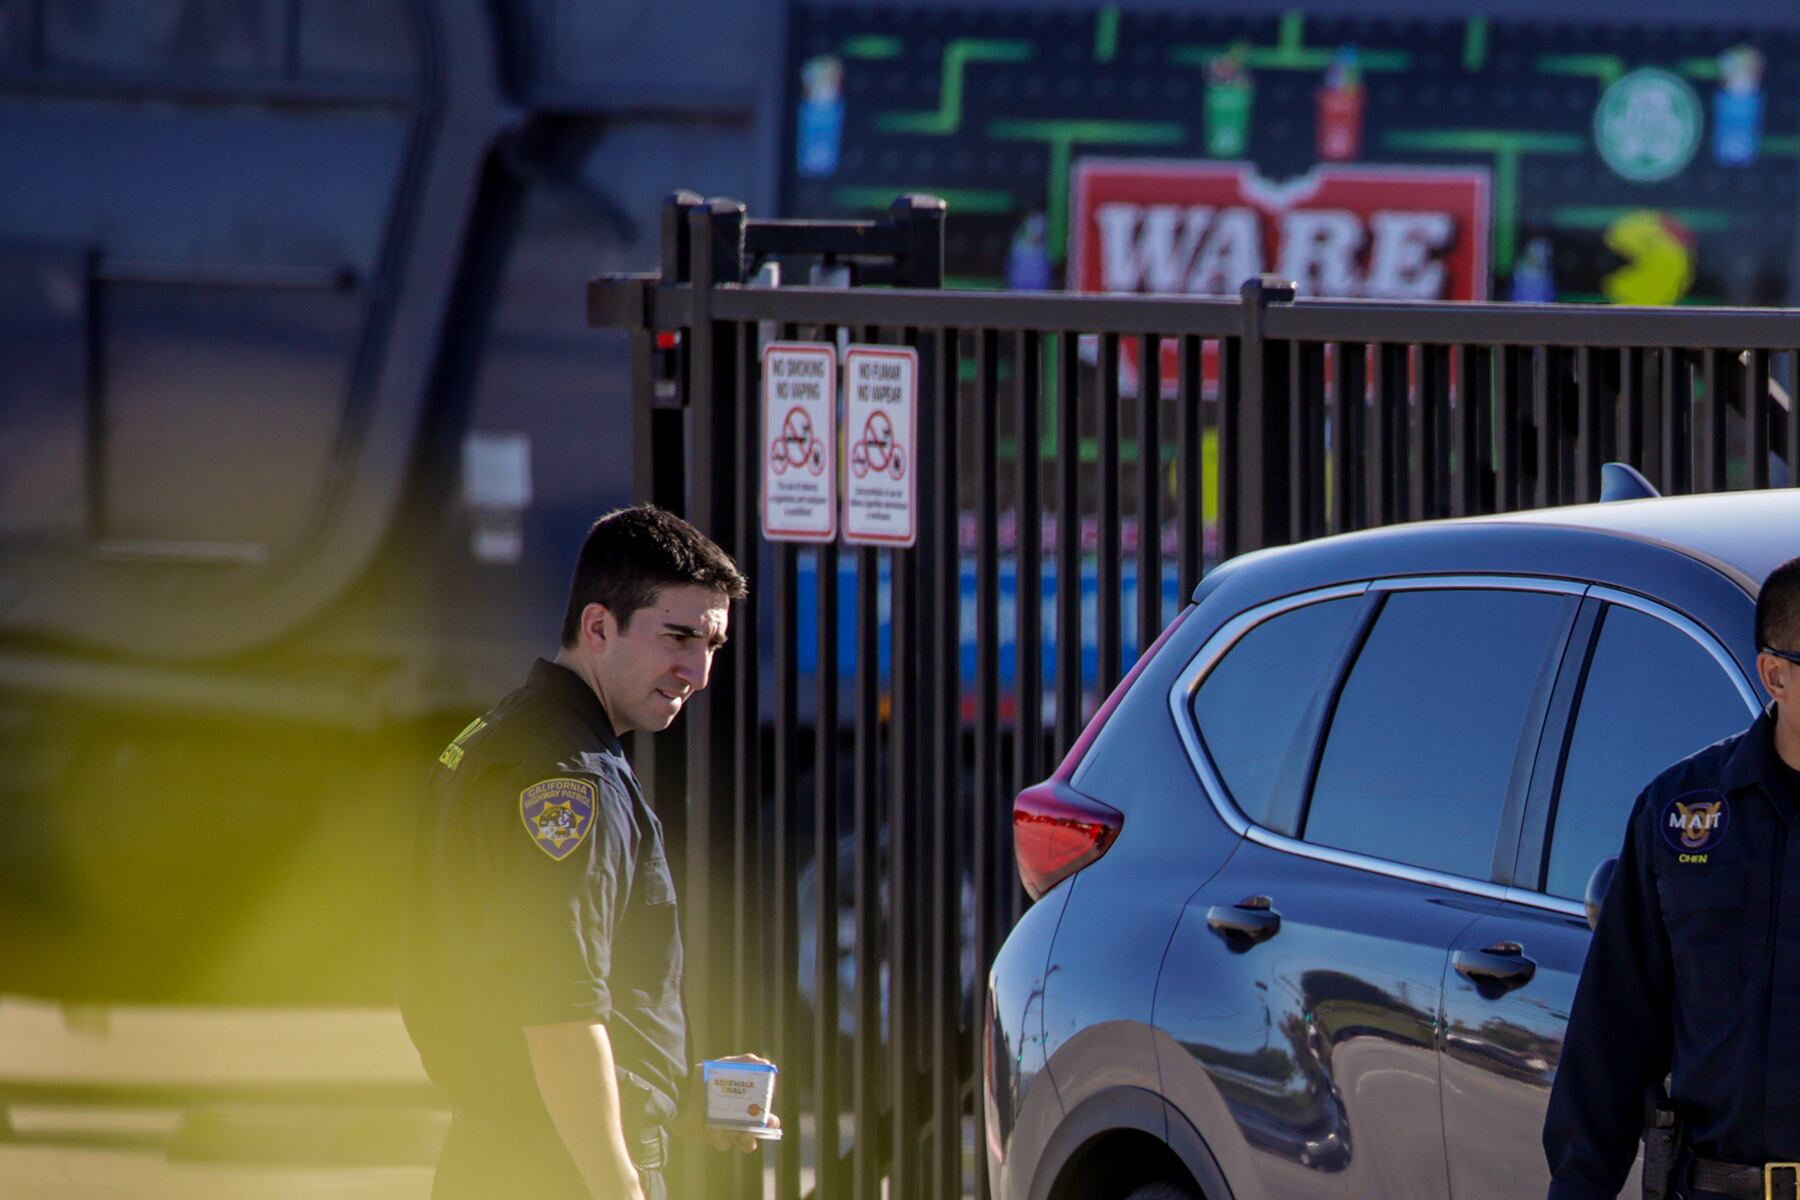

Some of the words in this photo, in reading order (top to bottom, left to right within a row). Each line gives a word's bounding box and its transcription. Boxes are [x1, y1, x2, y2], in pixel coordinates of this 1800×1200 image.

[1095, 203, 1453, 298] WARE
[773, 359, 784, 377] NO
[859, 362, 870, 380] NO
[777, 382, 788, 400] NO
[857, 384, 868, 401] NO
[528, 782, 587, 798] CALIFORNIA
[525, 790, 561, 809] HIGHWAY
[561, 790, 591, 809] PATROL
[1669, 812, 1722, 829] MAIT
[1678, 853, 1708, 863] CHEN
